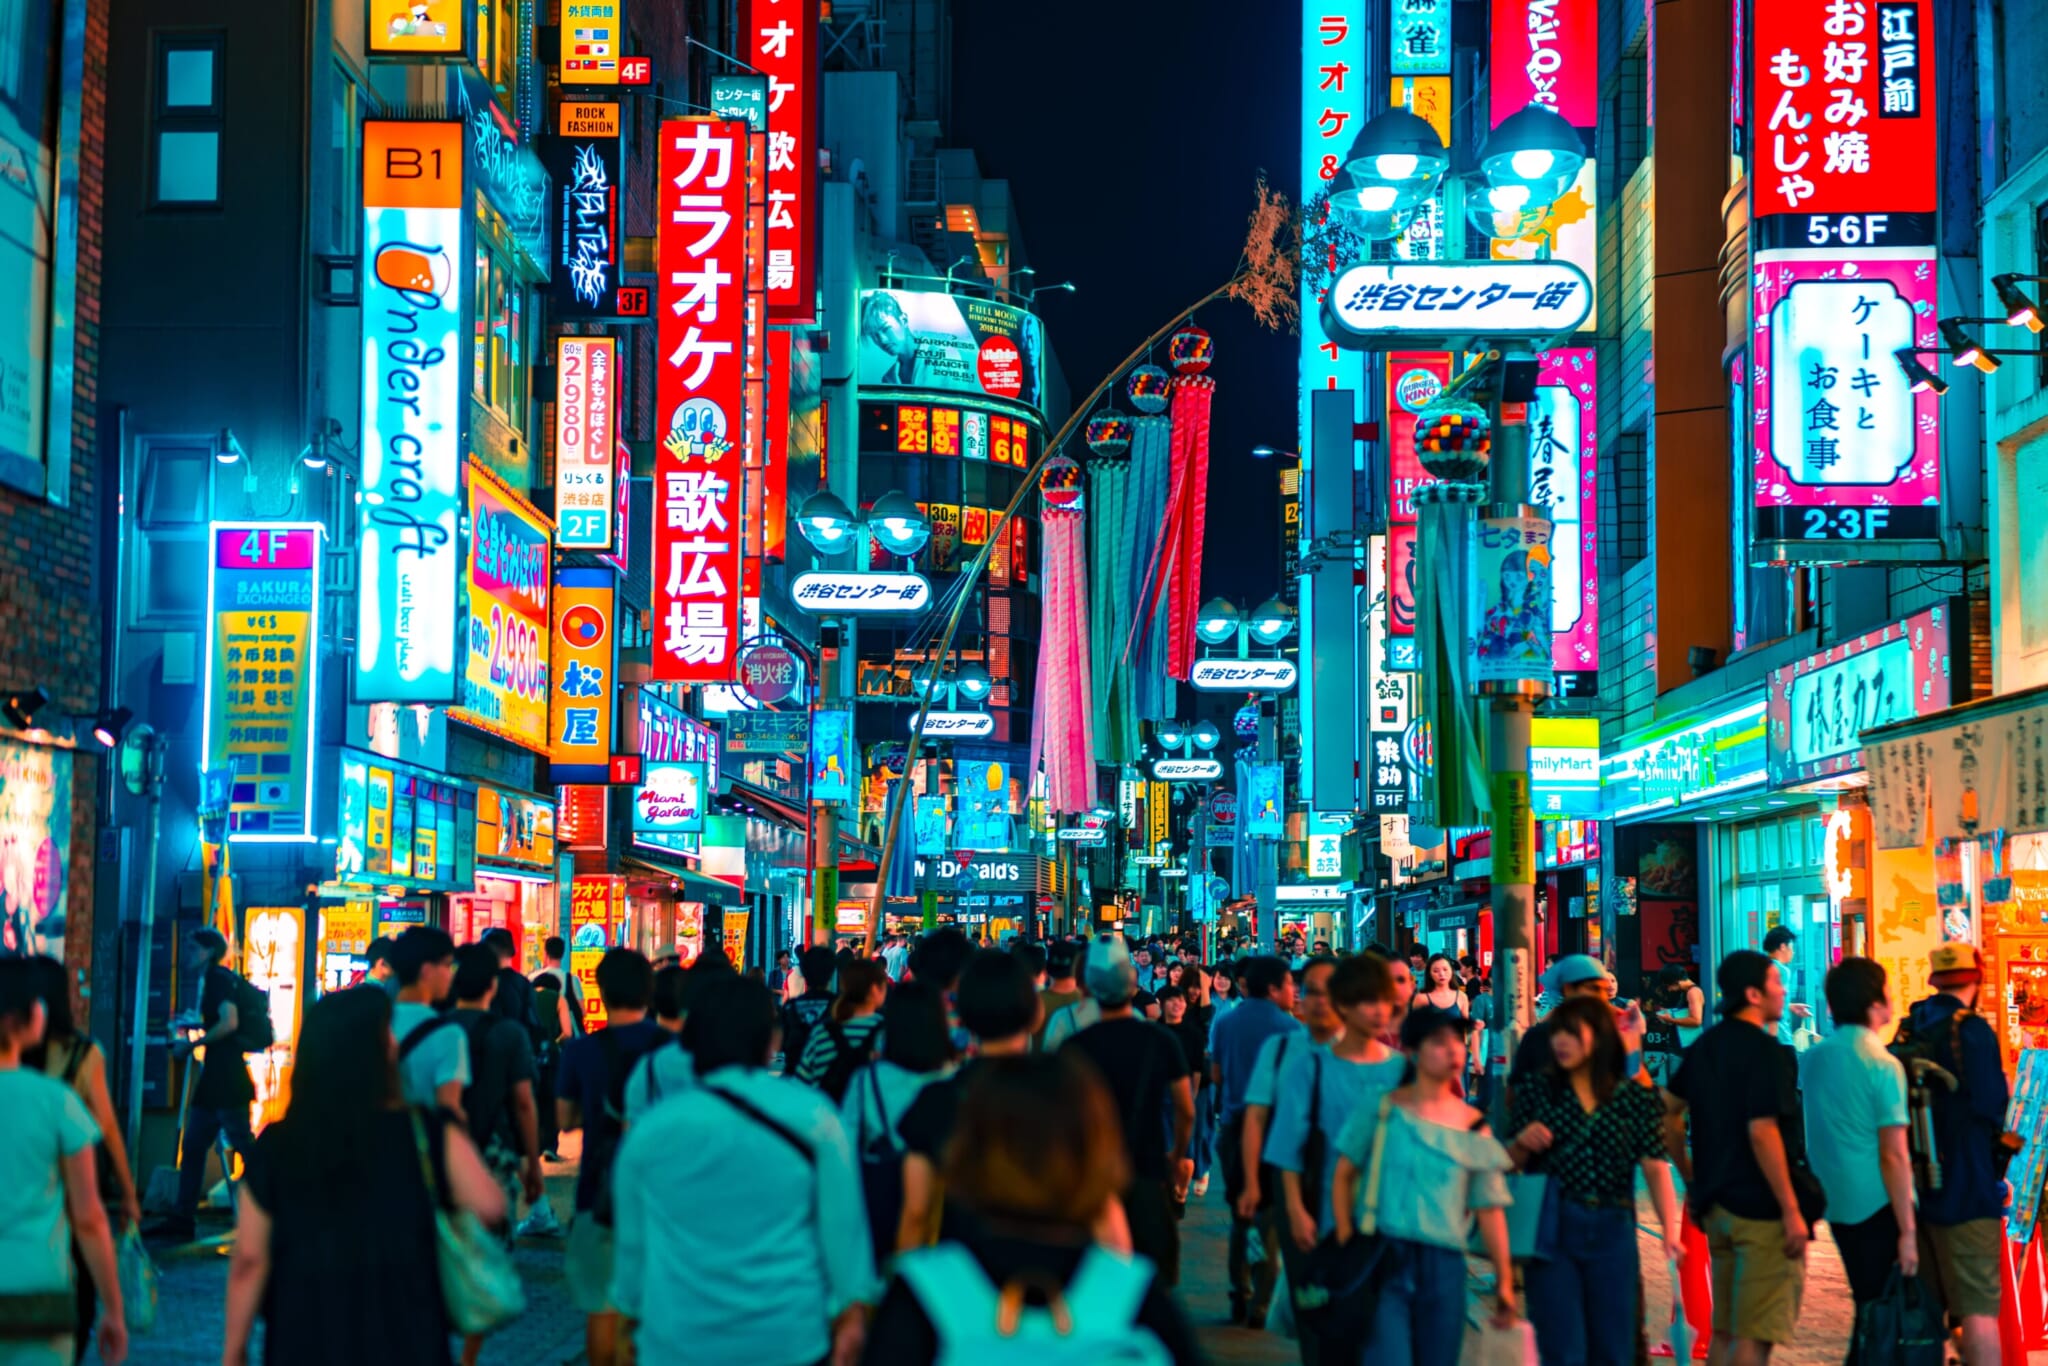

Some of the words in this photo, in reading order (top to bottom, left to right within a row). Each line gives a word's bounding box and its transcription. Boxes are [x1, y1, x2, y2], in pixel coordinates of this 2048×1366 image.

[621, 63, 648, 80] 4F
[1881, 8, 1914, 113] 江戸前
[576, 107, 606, 119] ROCK
[567, 121, 614, 133] FASHION
[1769, 48, 1814, 208] もんじゃ
[386, 148, 442, 179] B1
[622, 291, 645, 312] 3F
[1344, 281, 1579, 312] 渋谷センター街
[1850, 295, 1881, 431] ケーキと
[665, 122, 735, 665] カラオケ歌広場
[1404, 388, 1436, 403] KING
[1805, 363, 1841, 471] お食事
[370, 433, 448, 559] craft
[567, 515, 601, 537] 2F
[239, 529, 289, 563] 4F
[237, 581, 312, 593] SAKURA
[797, 582, 922, 601] 渋谷センター街
[746, 662, 792, 685] 消火栓
[1198, 667, 1293, 681] 渋谷センター街
[561, 660, 602, 746] 松屋
[637, 791, 686, 804] Miami
[1376, 794, 1404, 806] B1F
[1320, 838, 1336, 854] 本
